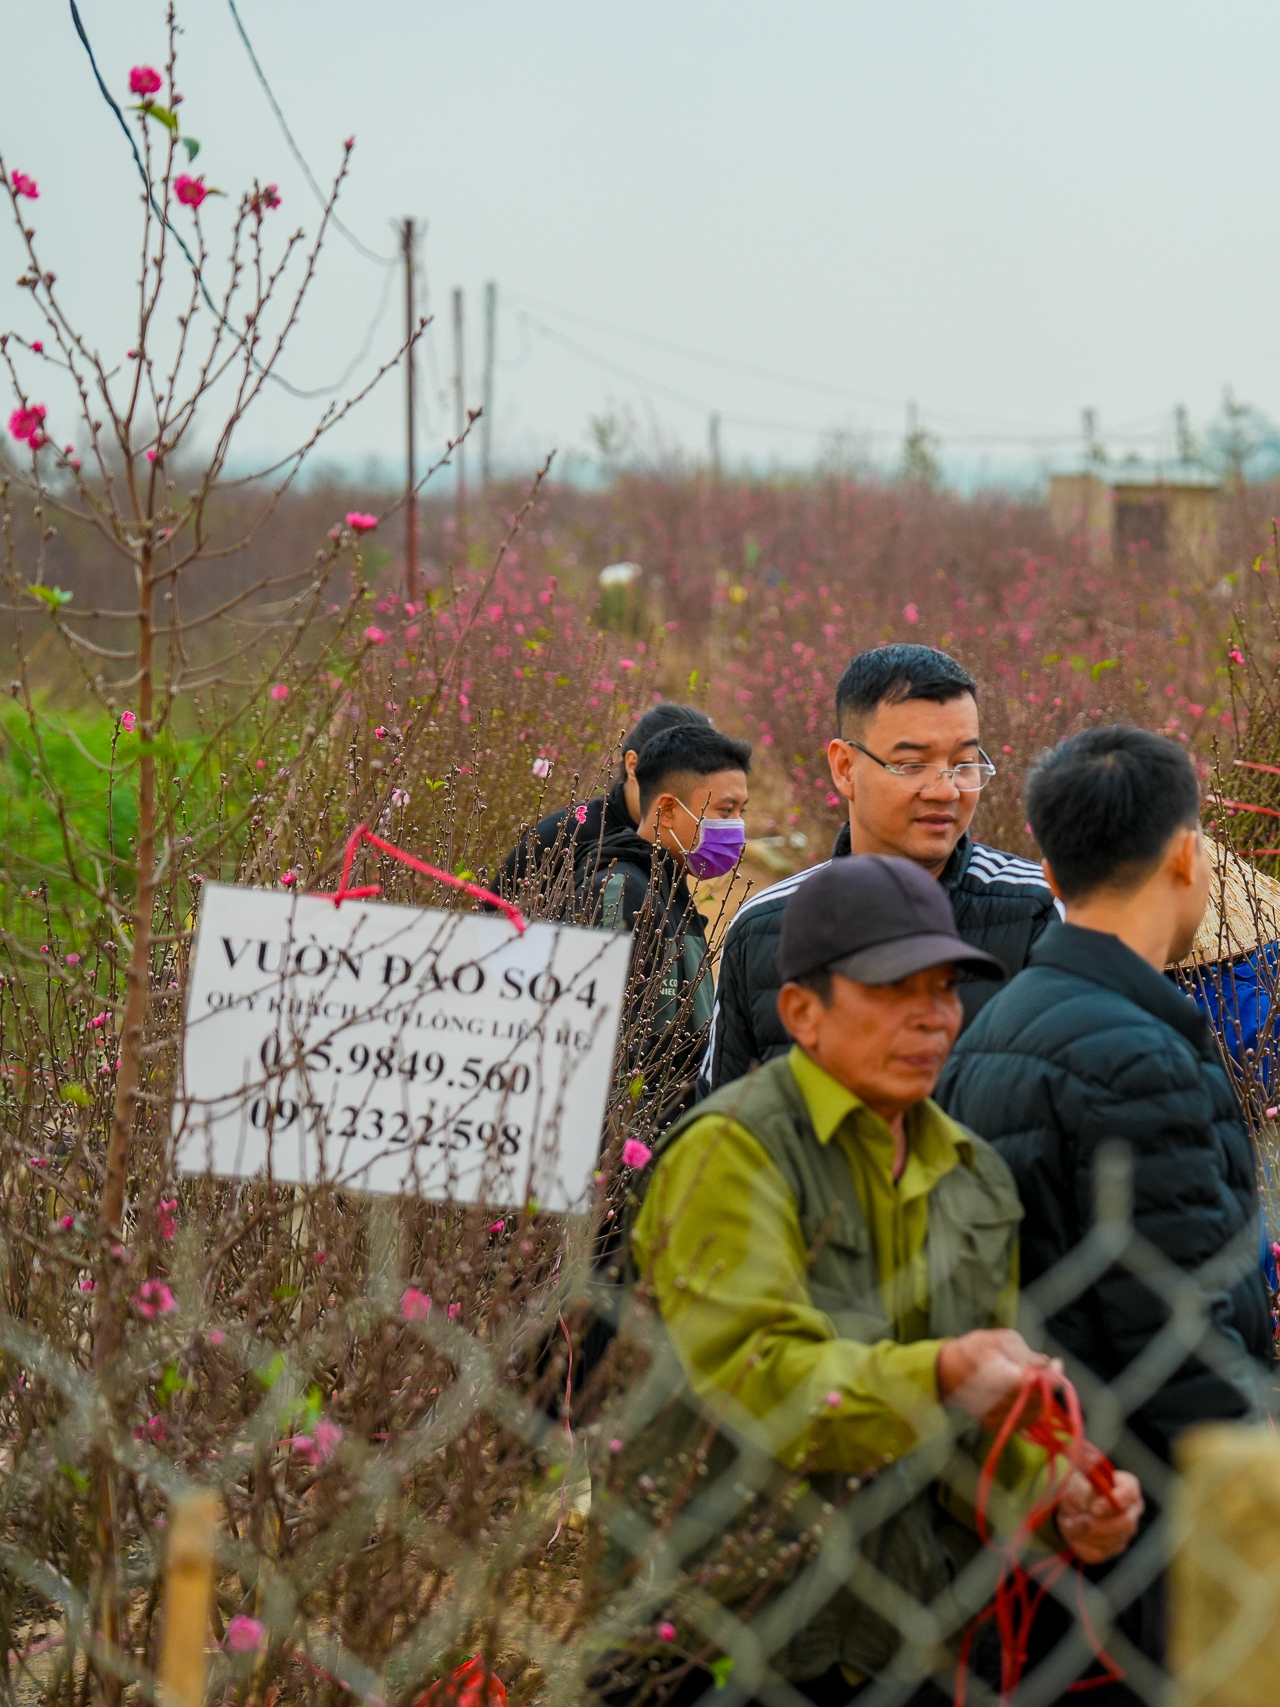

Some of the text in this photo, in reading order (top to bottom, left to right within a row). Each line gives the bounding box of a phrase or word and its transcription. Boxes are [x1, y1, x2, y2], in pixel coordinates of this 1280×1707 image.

[575, 978, 598, 1009] 4
[415, 1008, 485, 1034] LÒNG
[260, 1035, 531, 1095] 05.9849.560
